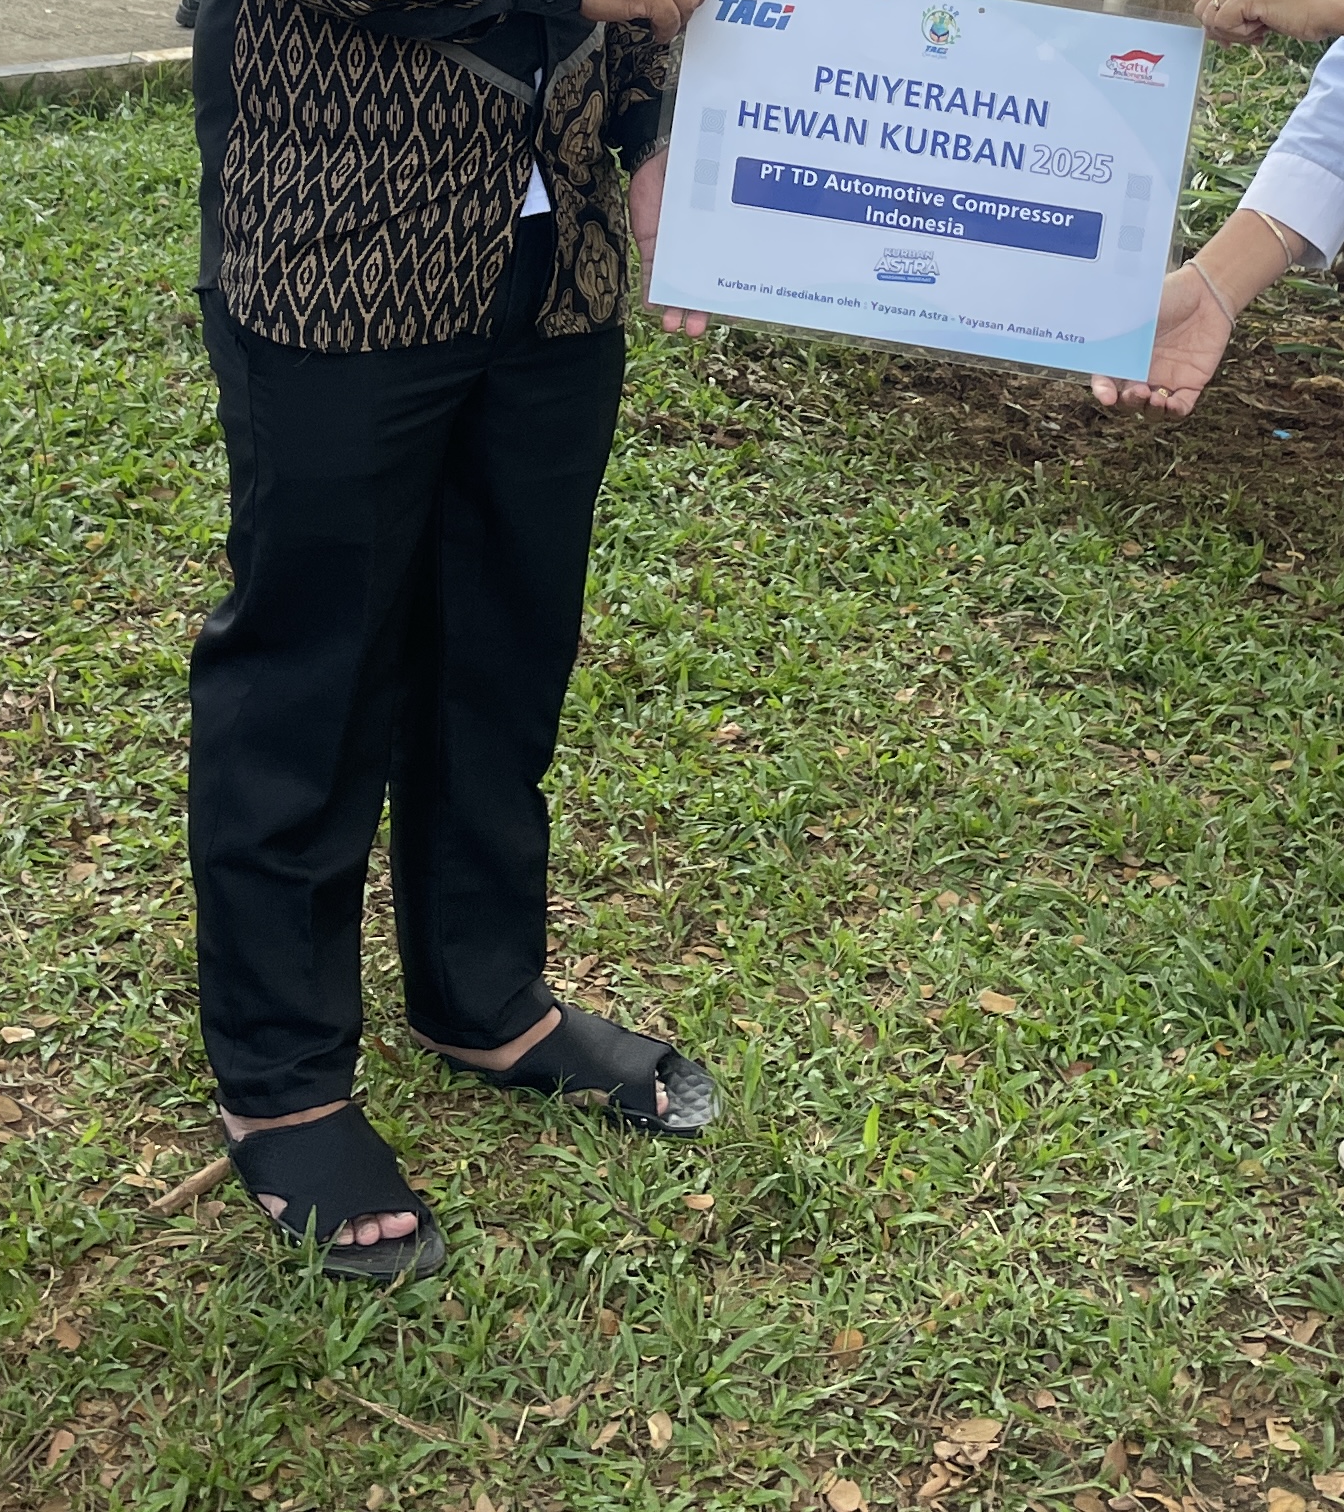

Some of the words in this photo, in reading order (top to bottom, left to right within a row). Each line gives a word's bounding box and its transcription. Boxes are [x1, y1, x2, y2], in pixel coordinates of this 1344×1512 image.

[814, 65, 1050, 128] PENYERAHAN
[737, 99, 869, 146] HEWAN
[880, 122, 1026, 171] KURBAN
[1030, 144, 1114, 183] 2025
[760, 163, 785, 182] PT
[791, 167, 818, 186] TD
[824, 173, 945, 207] Automotive
[952, 193, 1074, 227] Compressor
[866, 205, 965, 236] Indonesia
[873, 256, 940, 275] ASTRA
[883, 248, 934, 260] KURBAN
[718, 277, 756, 292] Kurban
[759, 283, 773, 294] ini
[776, 286, 833, 304] disediakan
[837, 296, 861, 308] oleh
[870, 300, 916, 317] Yayasan
[919, 309, 948, 322] Astra
[958, 314, 1004, 331] Yayasan
[1055, 330, 1086, 344] Astra
